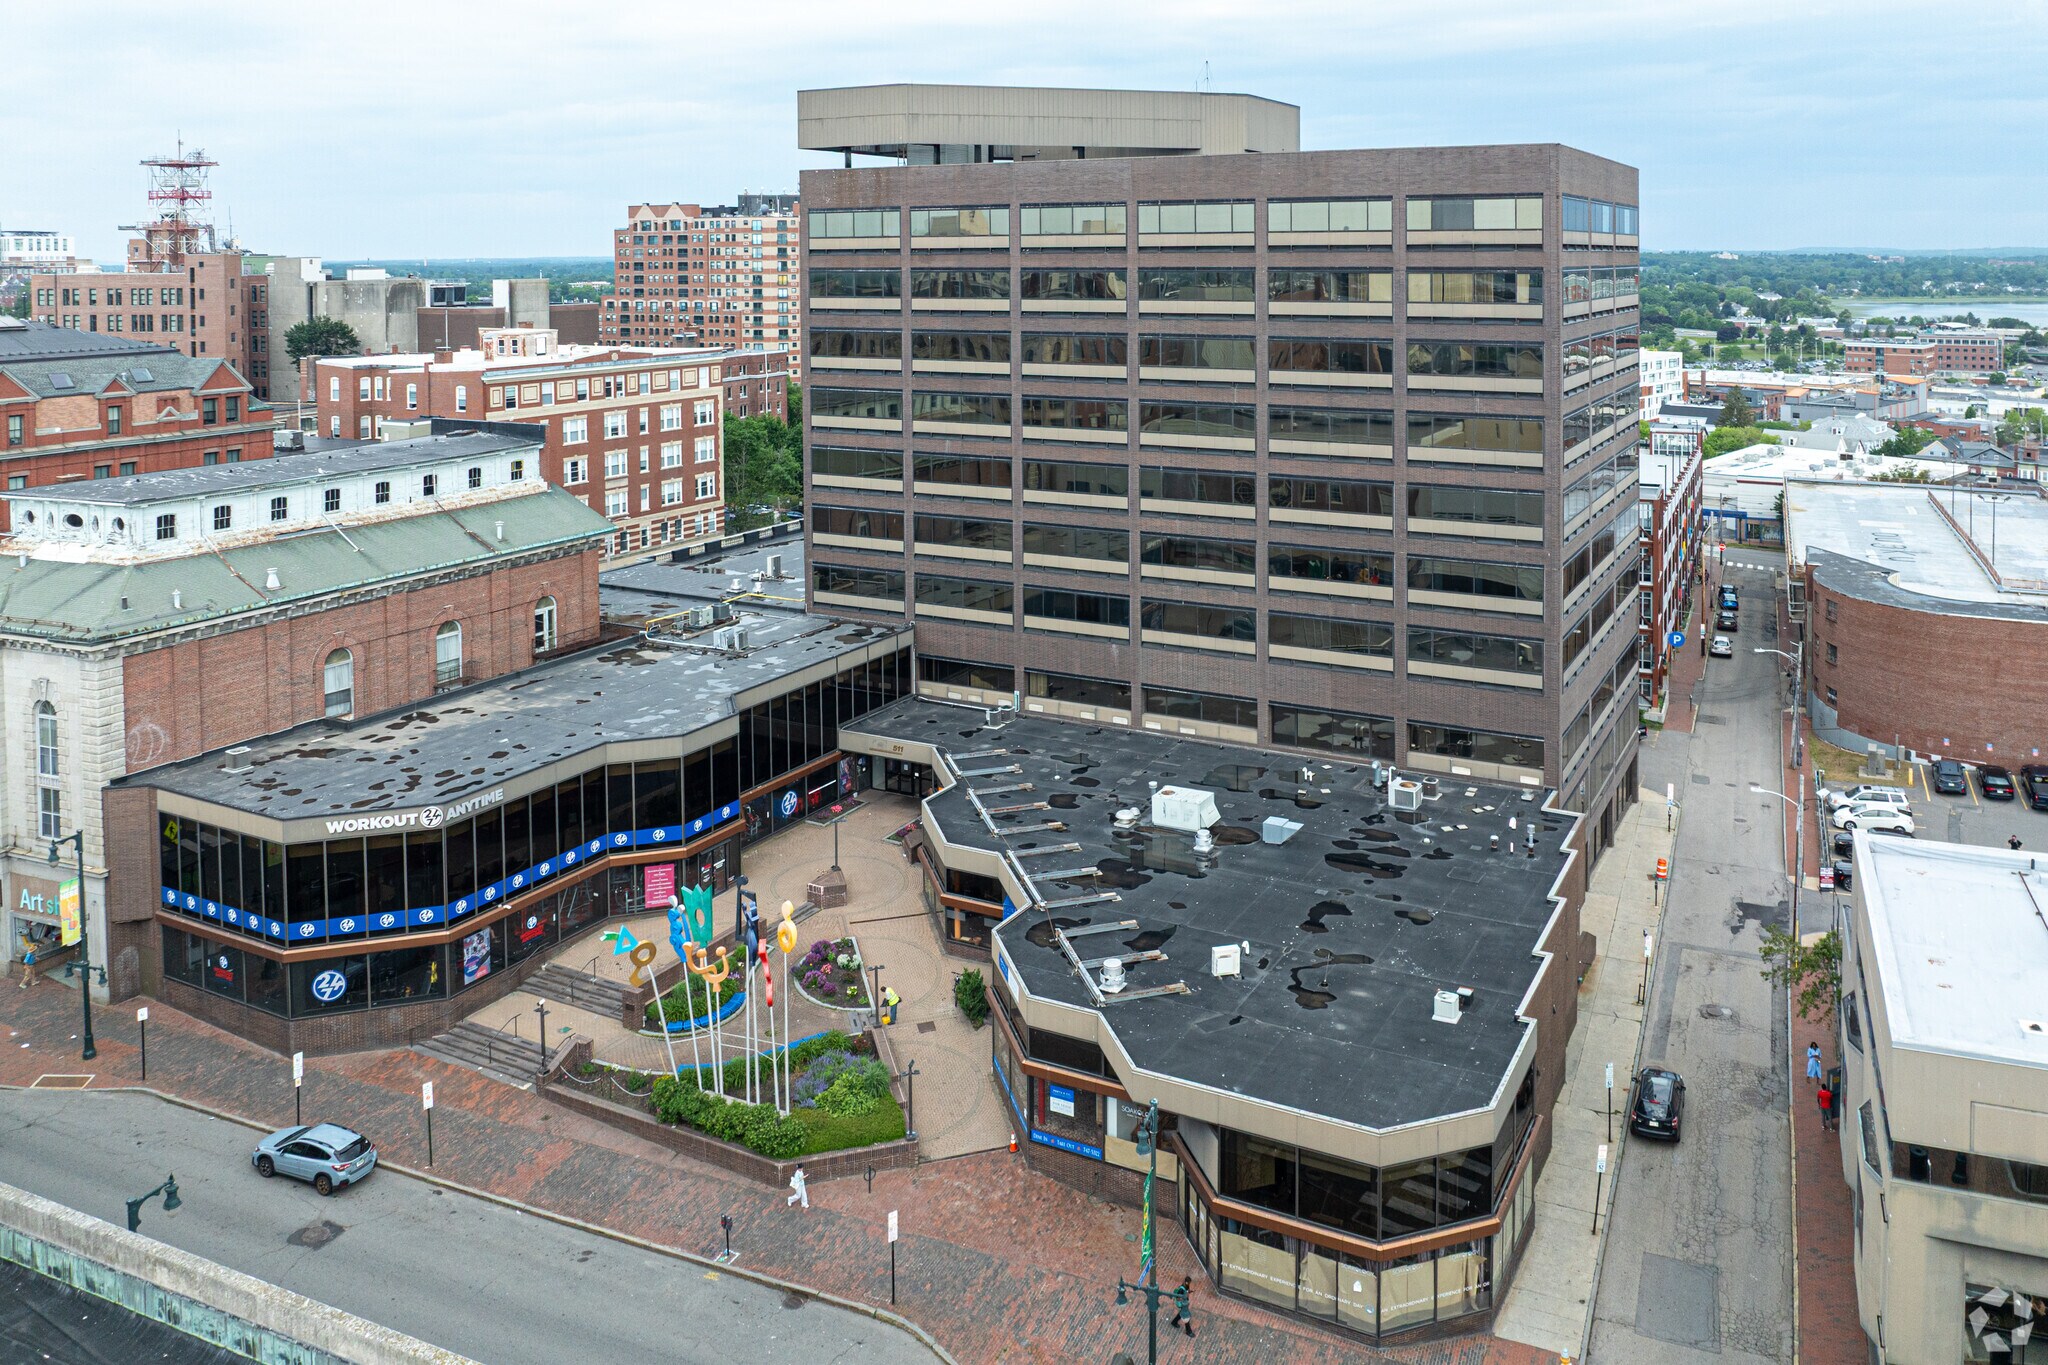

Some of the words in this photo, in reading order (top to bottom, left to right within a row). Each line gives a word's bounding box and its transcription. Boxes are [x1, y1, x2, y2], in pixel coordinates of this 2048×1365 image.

[892, 744, 904, 753] 511
[325, 812, 419, 834] WORKOUT
[445, 787, 504, 821] ANYTIME
[19, 888, 44, 913] Art
[1121, 1105, 1151, 1118] SOAKOLO
[1229, 1263, 1269, 1279] EXTRAORDINARY
[1302, 1286, 1314, 1294] FOR
[1390, 1296, 1429, 1311] EXTRAORDINARY
[1430, 1288, 1462, 1301] EPERIENCE
